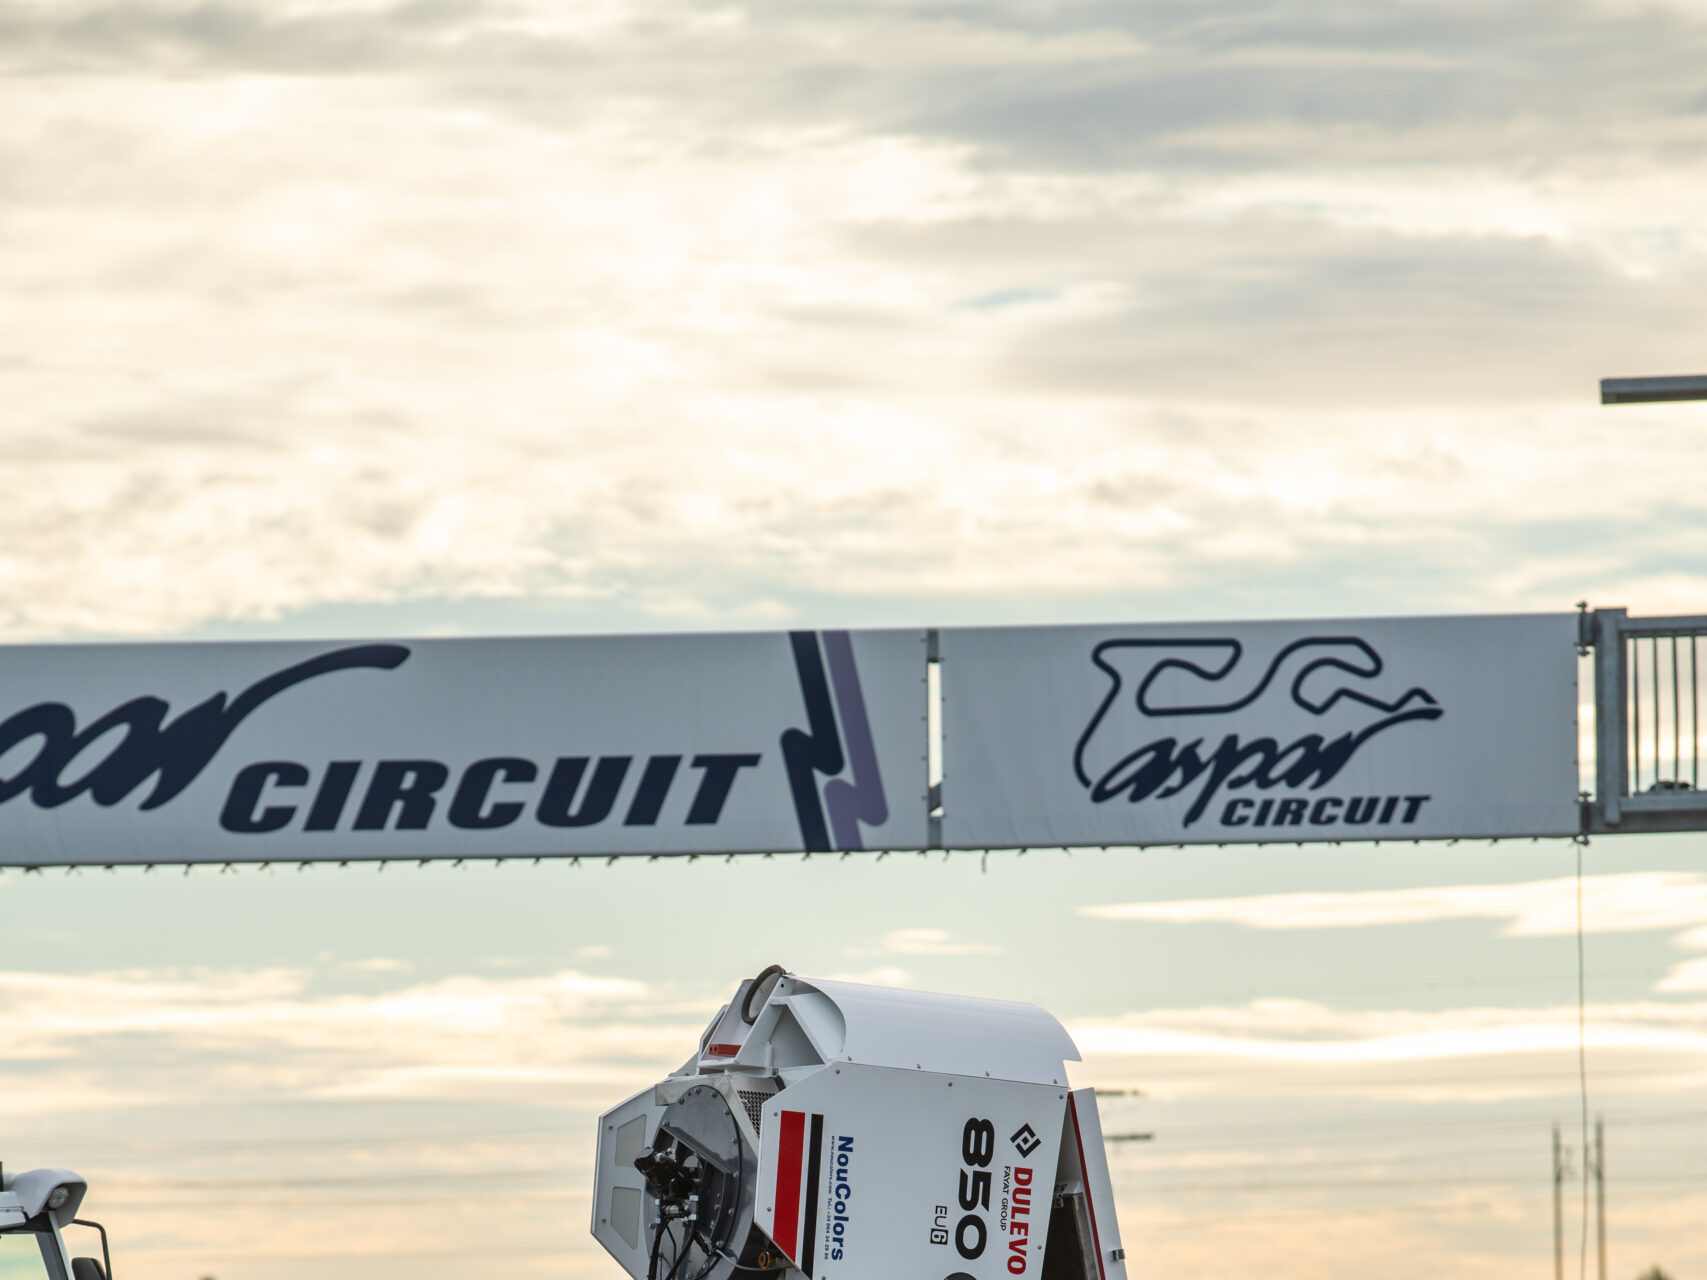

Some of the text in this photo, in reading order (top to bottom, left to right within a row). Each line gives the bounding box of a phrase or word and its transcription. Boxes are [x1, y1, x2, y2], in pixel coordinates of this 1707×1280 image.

[219, 752, 763, 834] CIRCUIT
[1219, 795, 1431, 827] CIRCUIT
[831, 1135, 854, 1261] NouColors
[954, 1117, 995, 1261] 850
[999, 1165, 1011, 1231] FAYAT GROUP
[1006, 1166, 1033, 1275] DULEVO
